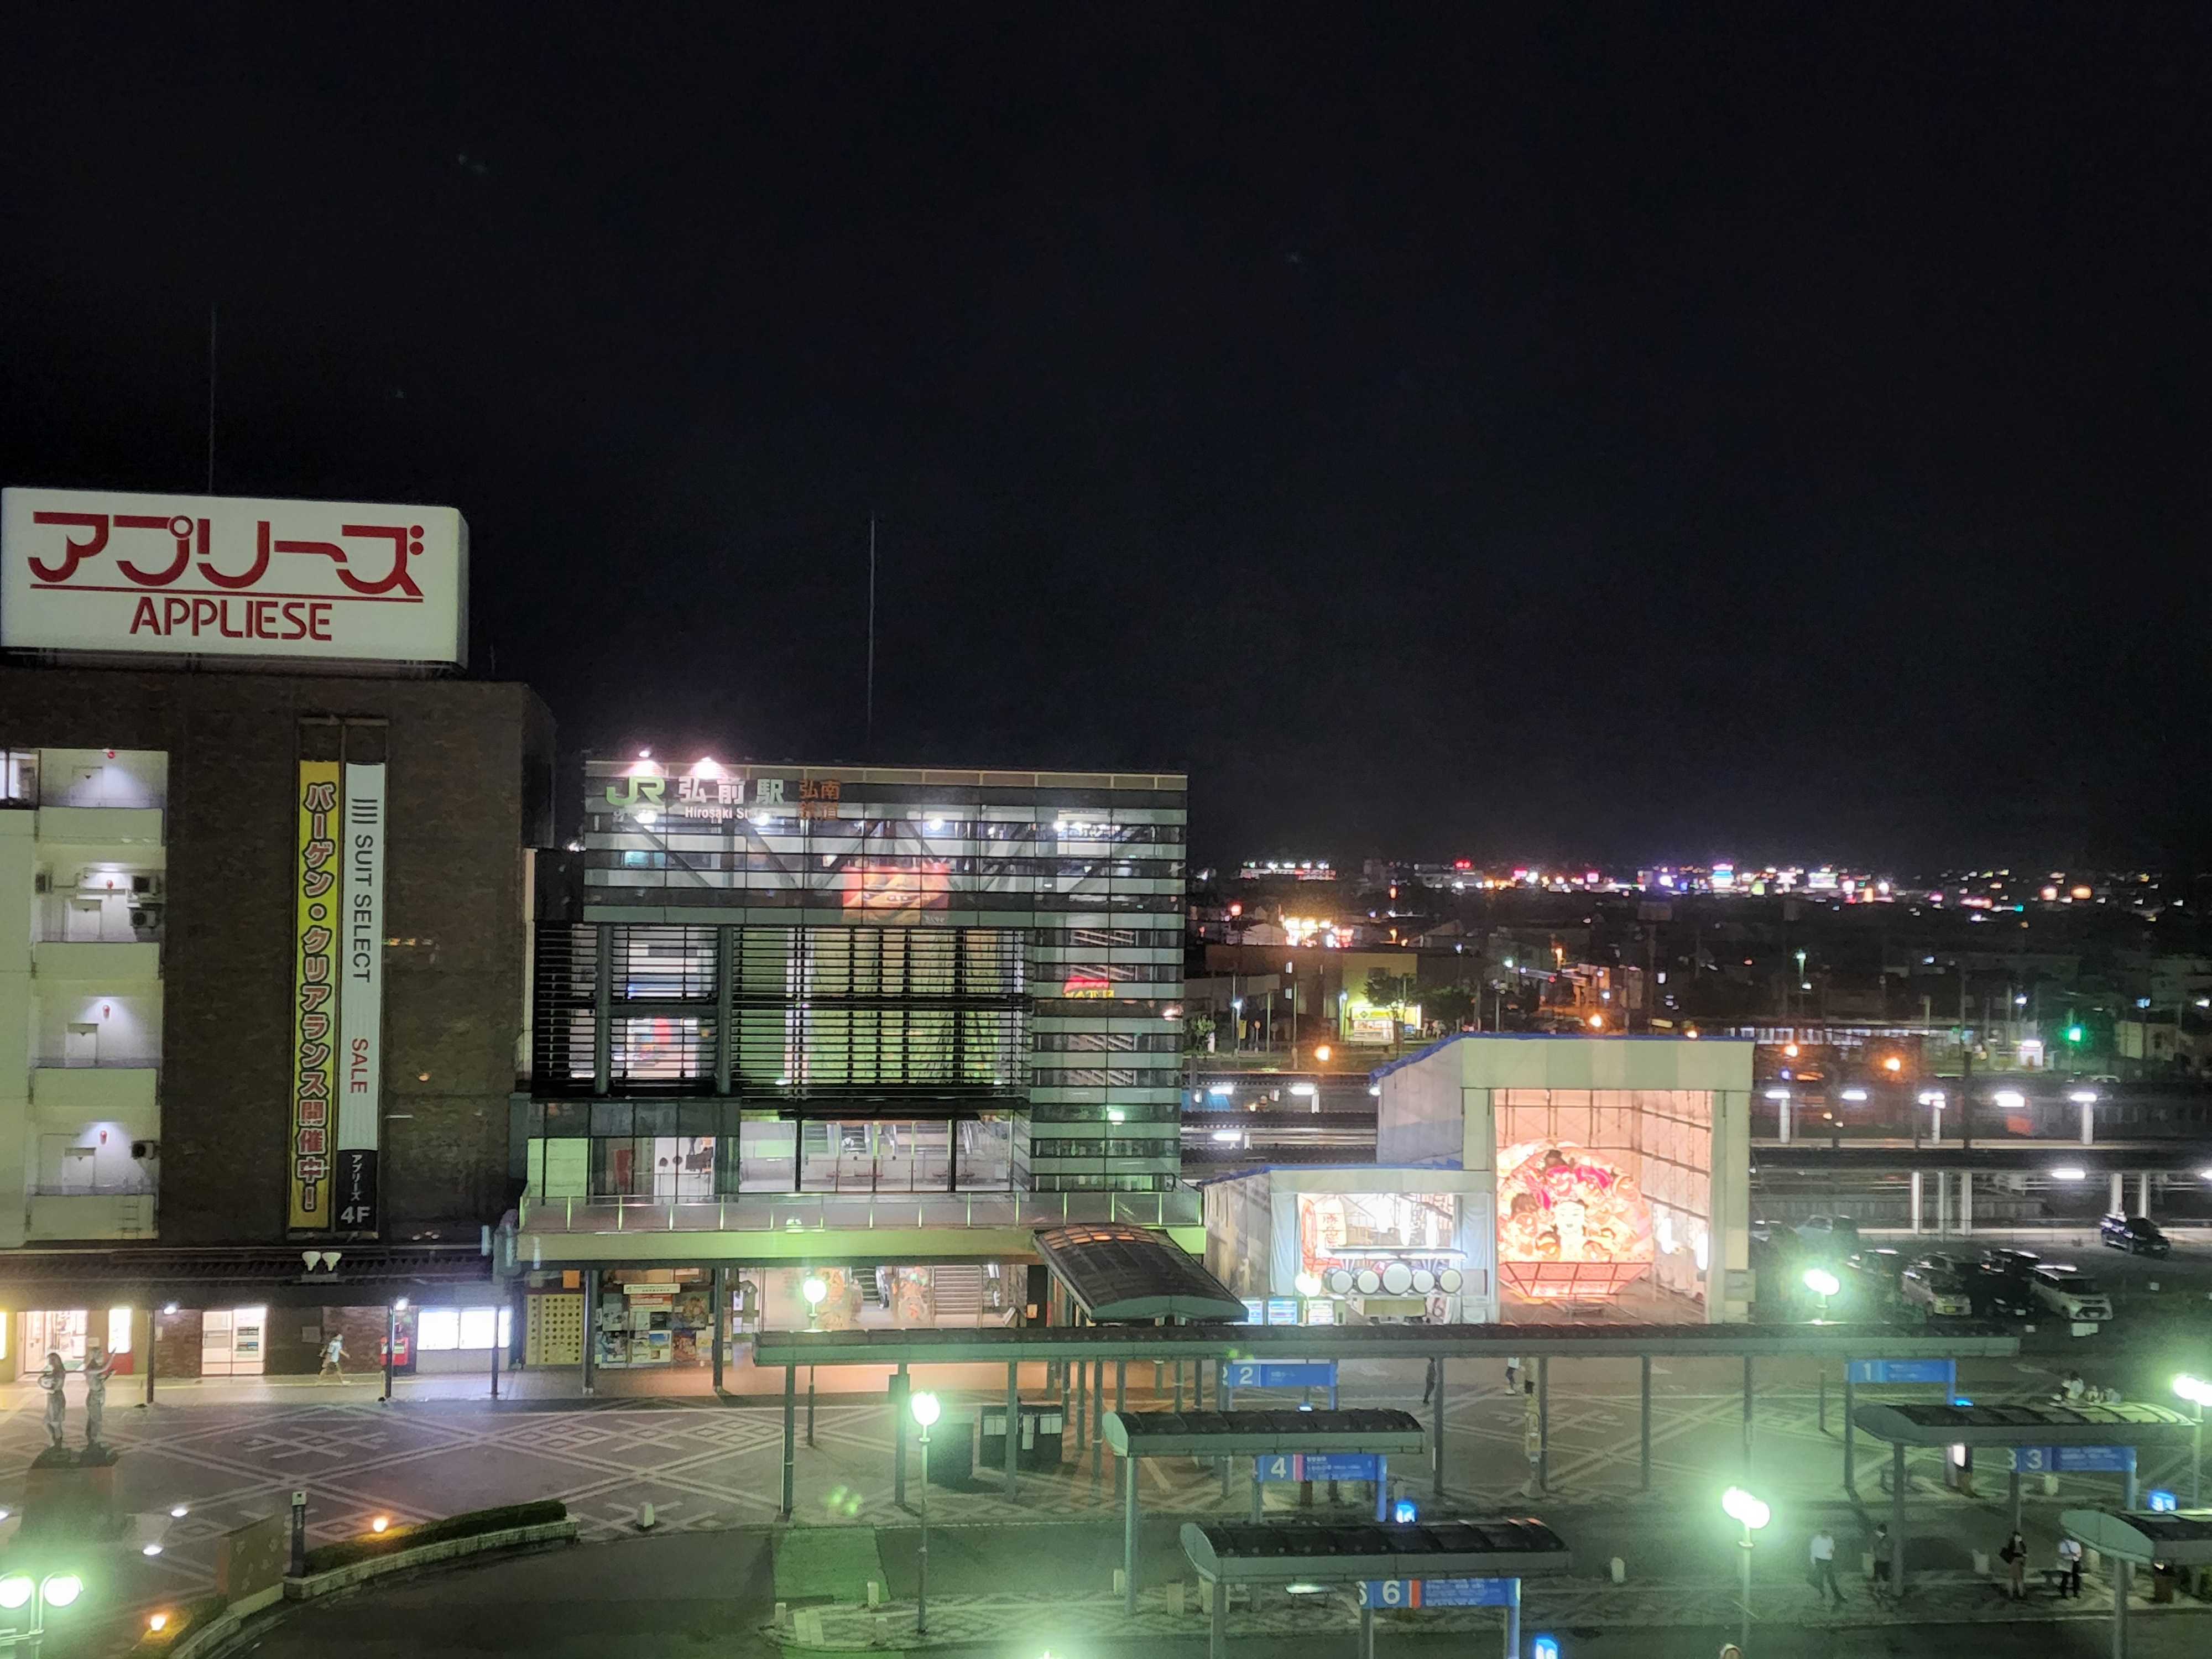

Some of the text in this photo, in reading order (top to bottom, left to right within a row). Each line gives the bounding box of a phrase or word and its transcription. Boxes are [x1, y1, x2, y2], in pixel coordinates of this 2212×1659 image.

[28, 511, 424, 597] アプリーズ
[130, 597, 333, 641] APPLIESE
[606, 776, 784, 806] JR 弘前駅
[685, 807, 733, 820] Hirosaki
[353, 834, 373, 983] SUIT SELECT
[350, 1038, 368, 1093] SALE
[341, 1206, 371, 1224] 4F
[1239, 1366, 1253, 1385] 2
[1863, 1363, 1871, 1380] 1
[1271, 1457, 1286, 1478] 4
[2026, 1449, 2042, 1469] 3
[1383, 1580, 1400, 1605] 6
